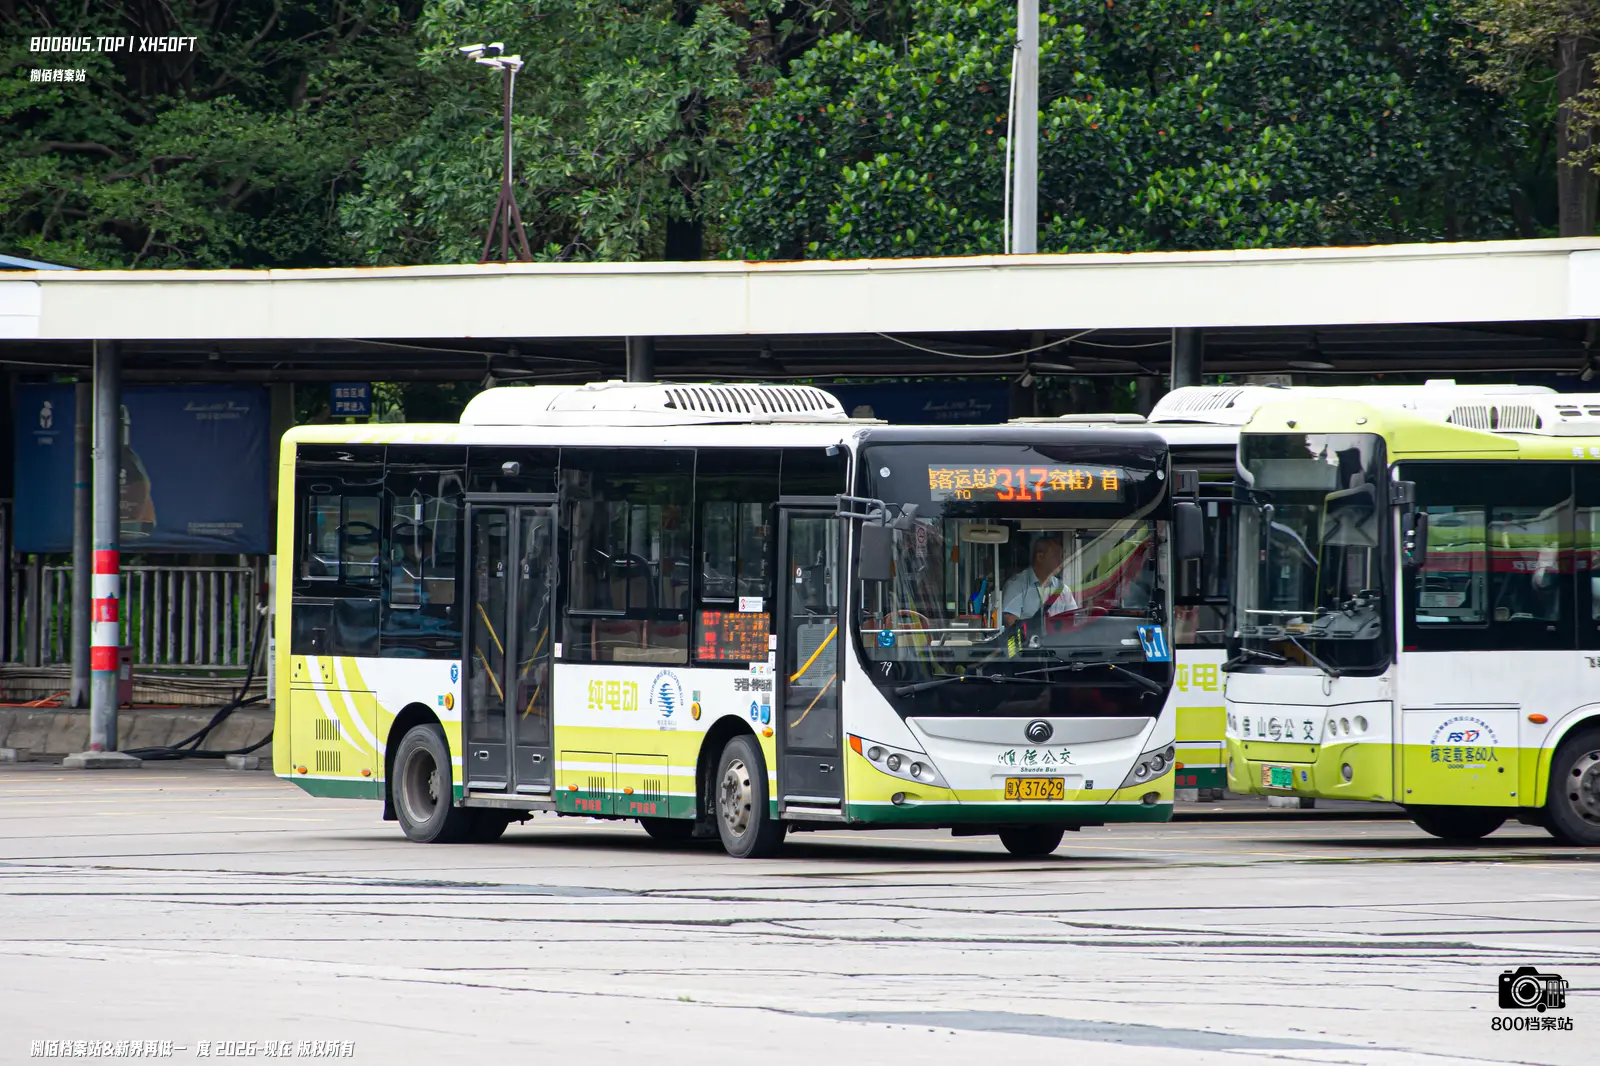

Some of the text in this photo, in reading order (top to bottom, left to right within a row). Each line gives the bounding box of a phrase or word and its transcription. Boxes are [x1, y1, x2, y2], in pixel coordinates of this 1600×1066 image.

[955, 490, 971, 499] TO
[995, 467, 1048, 500] 317
[588, 680, 638, 711] 纯电动
[1430, 746, 1498, 763] 核定载客60人
